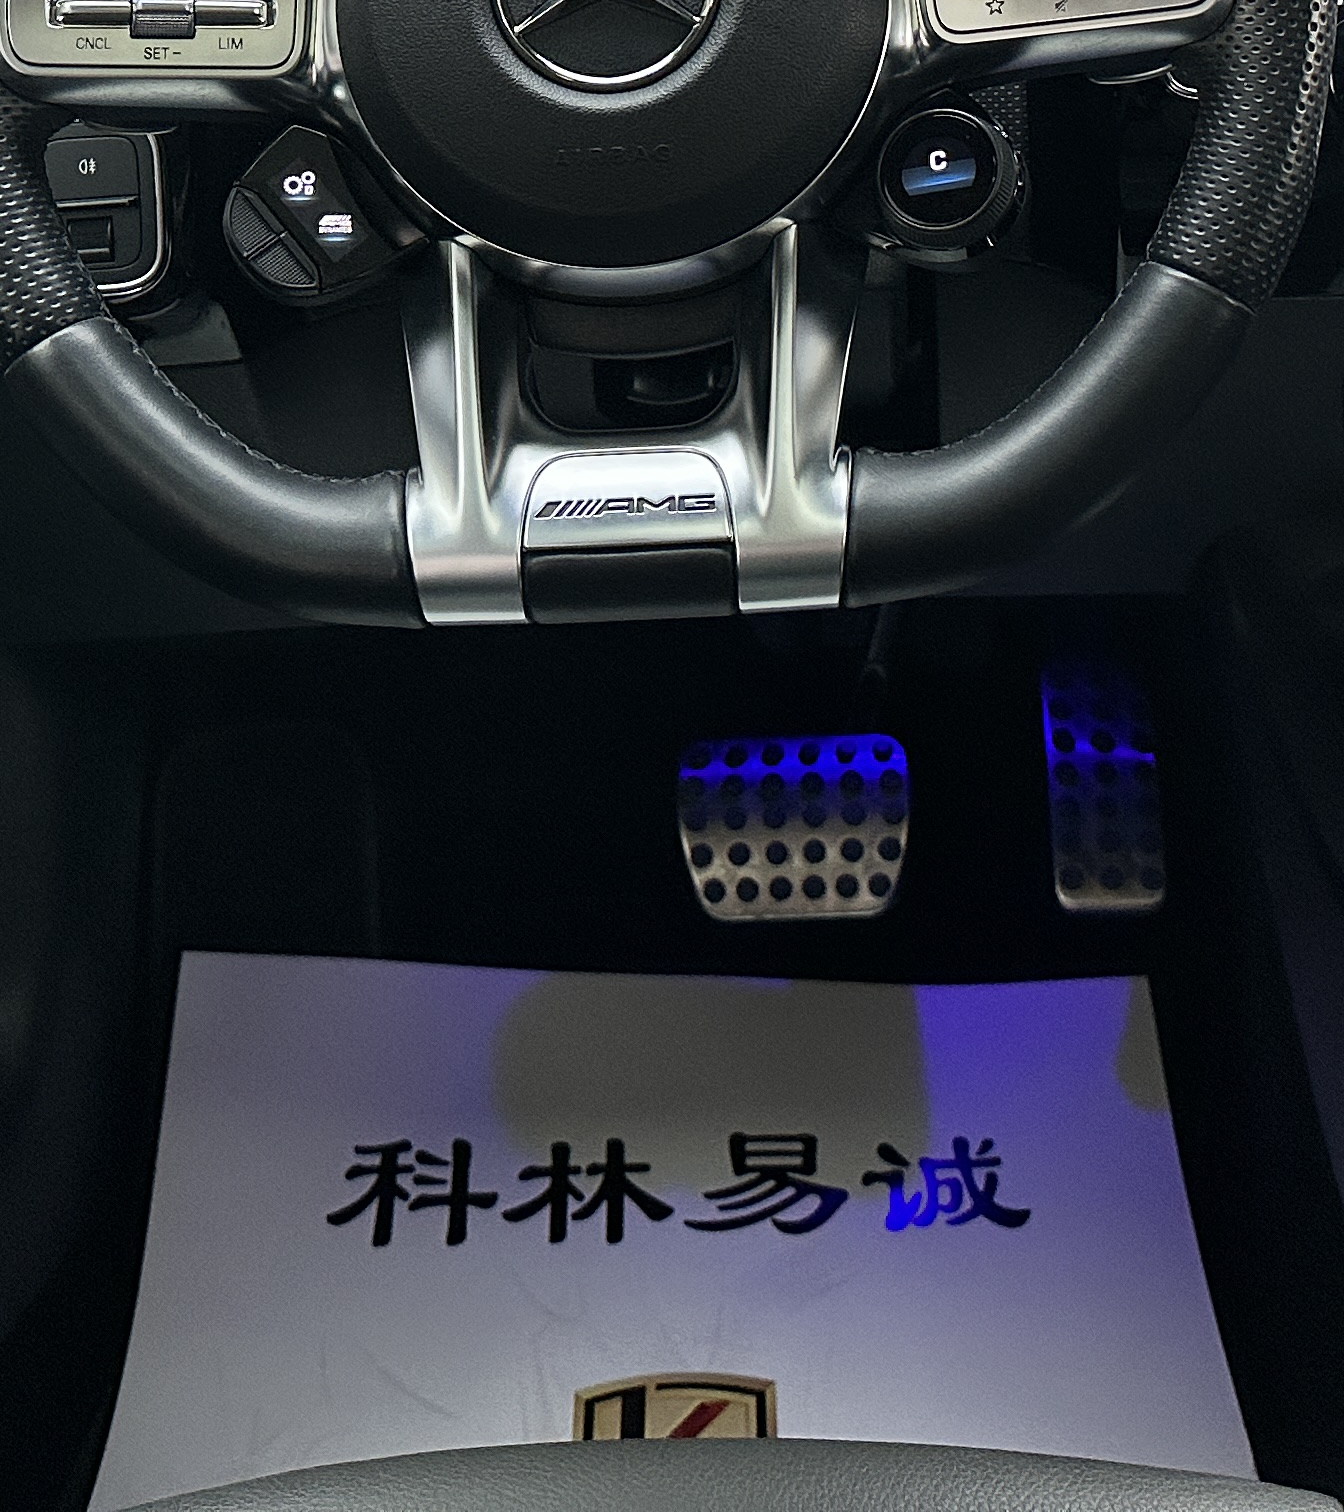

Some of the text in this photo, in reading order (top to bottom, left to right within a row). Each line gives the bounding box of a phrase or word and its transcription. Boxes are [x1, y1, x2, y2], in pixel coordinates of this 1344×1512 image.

[75, 37, 112, 50] CNCL
[218, 37, 243, 50] LIM
[929, 150, 948, 171] C
[593, 493, 717, 516] AMG
[326, 1132, 1032, 1247] 科林易诚
